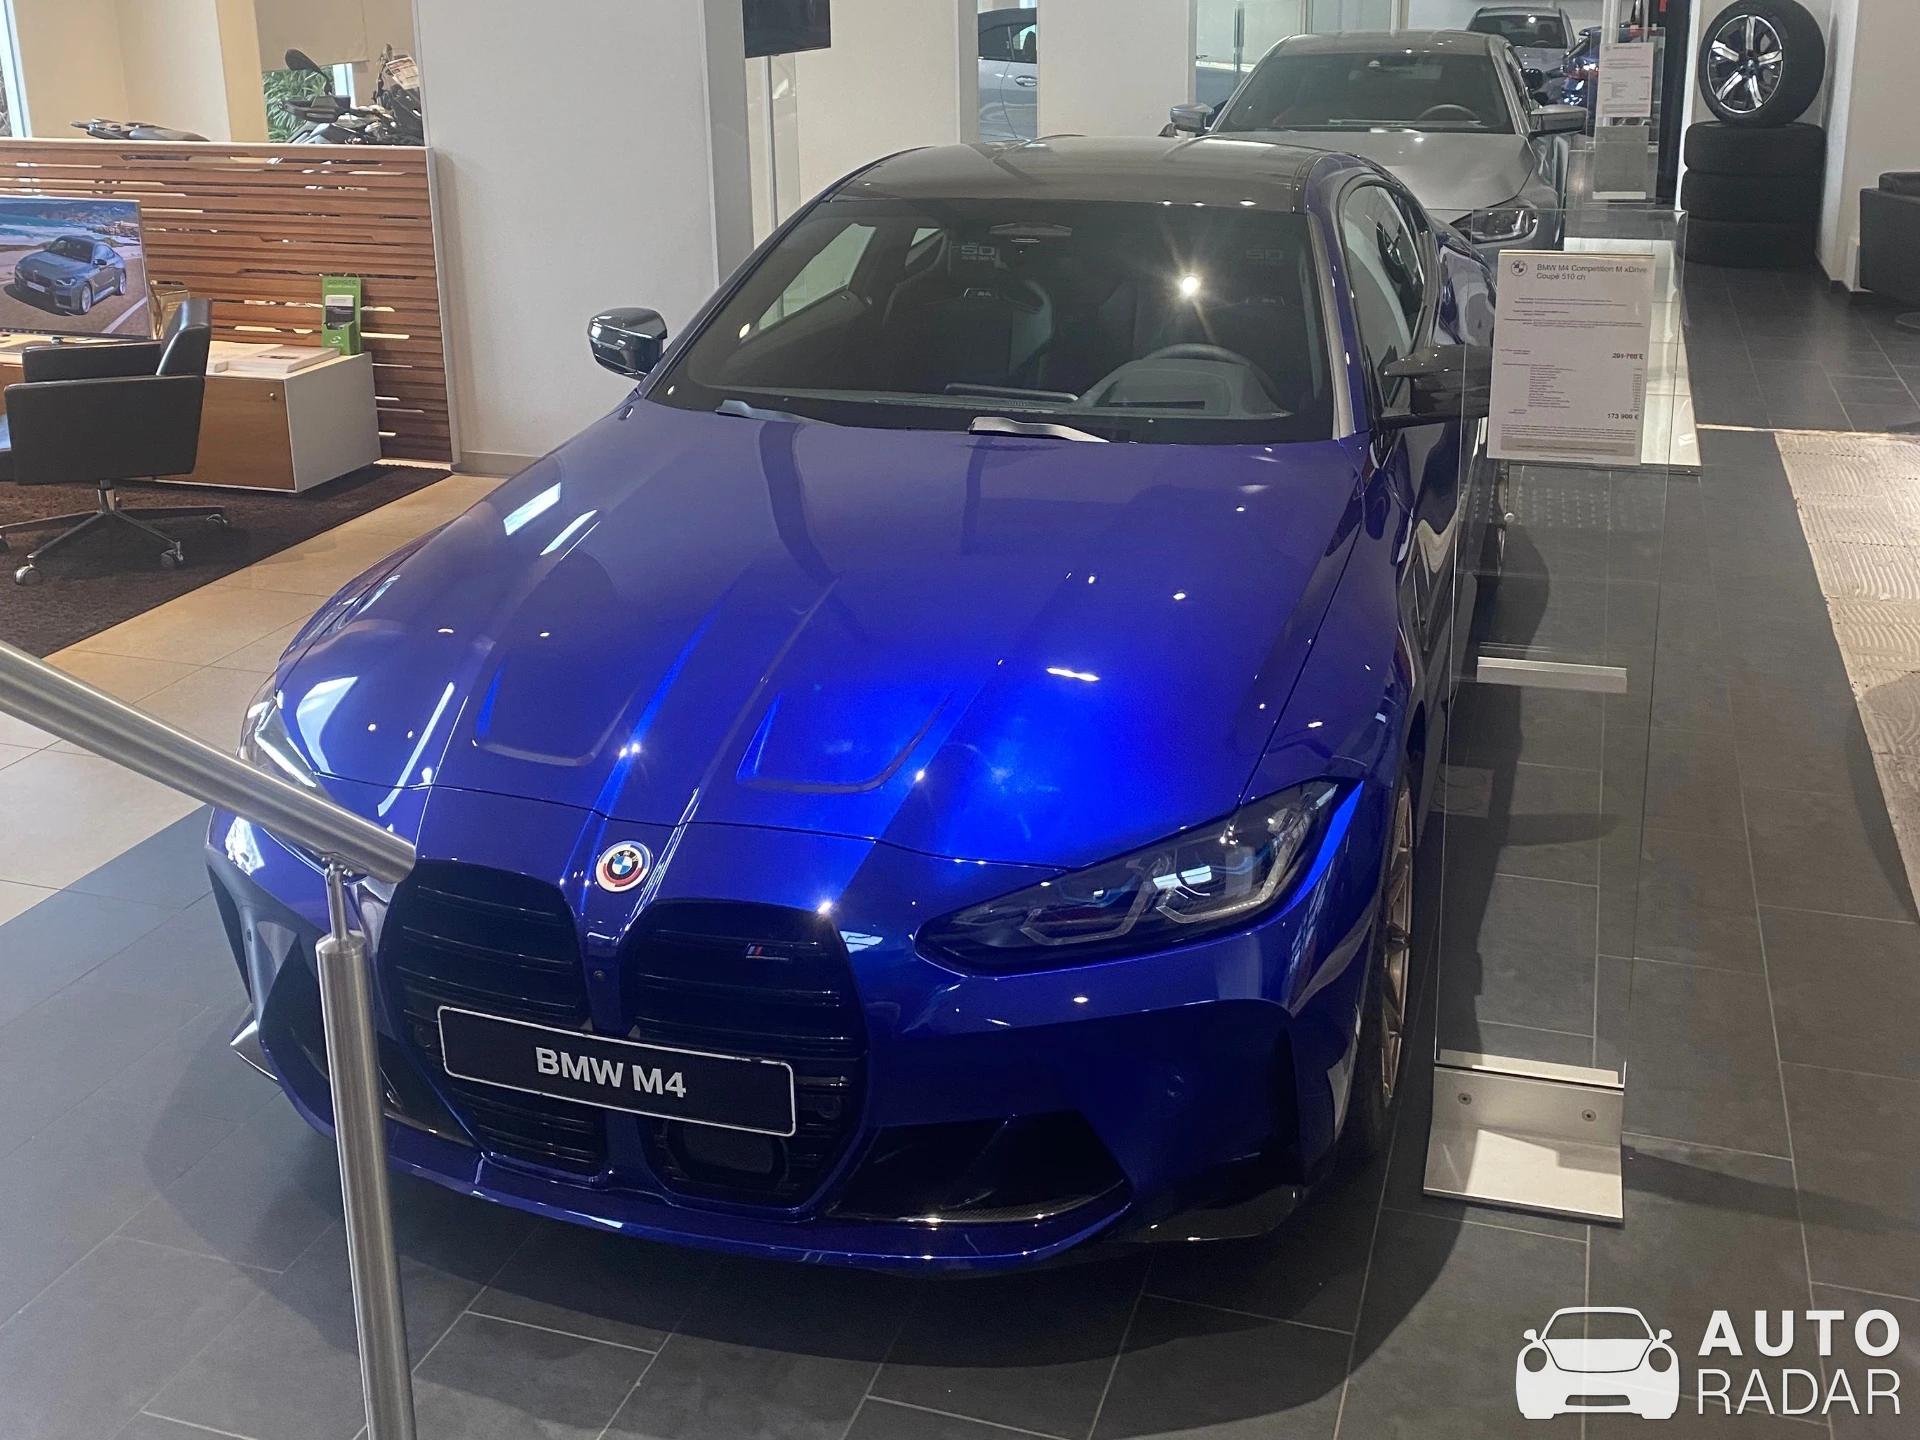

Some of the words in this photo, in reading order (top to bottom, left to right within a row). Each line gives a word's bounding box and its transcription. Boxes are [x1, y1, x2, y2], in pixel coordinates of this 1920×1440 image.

[1571, 264, 1614, 273] Competition
[1537, 272, 1560, 281] Coupé
[535, 1046, 624, 1088] BMW
[632, 1064, 687, 1098] M4
